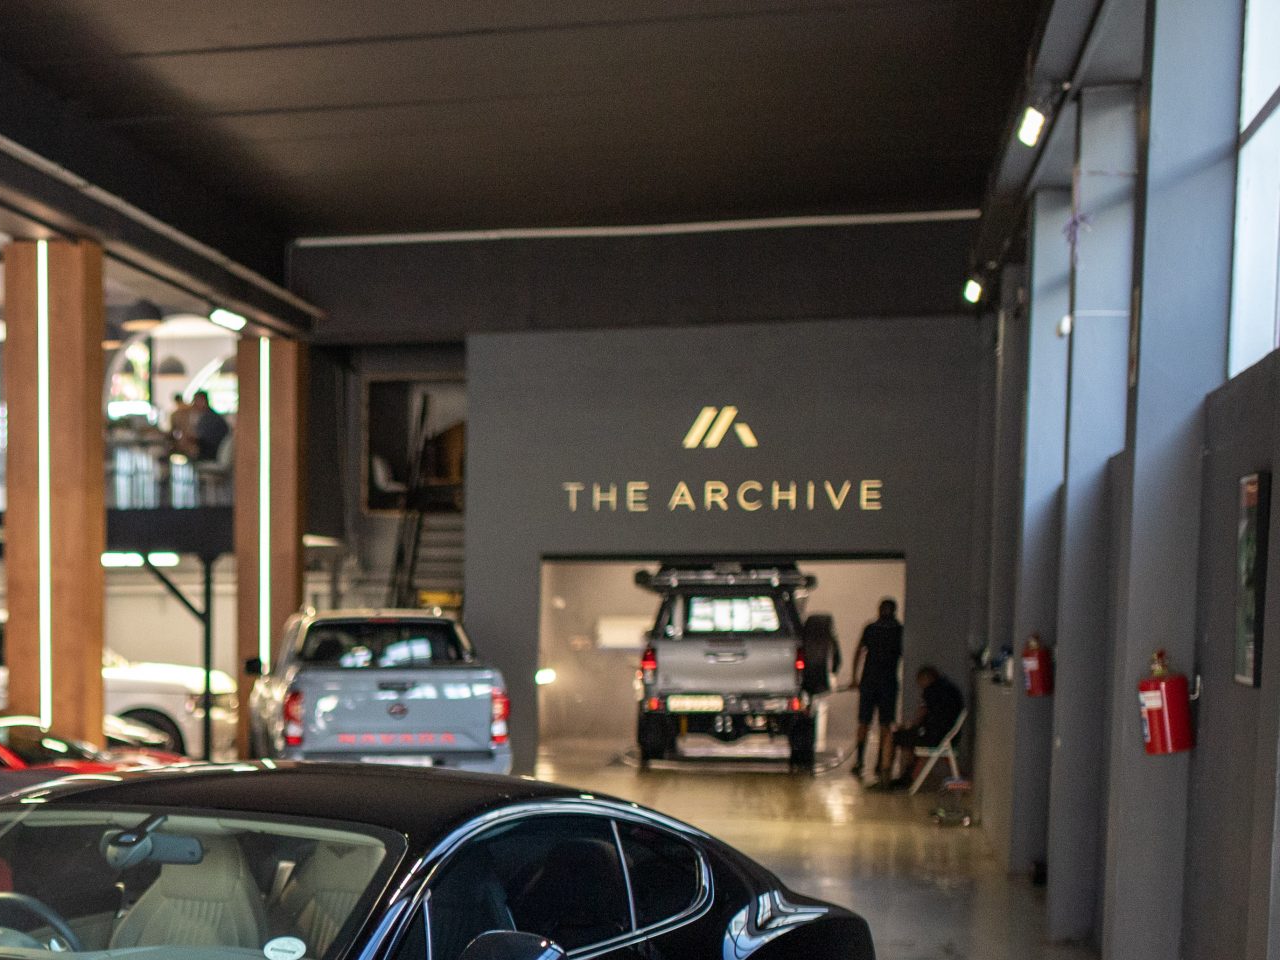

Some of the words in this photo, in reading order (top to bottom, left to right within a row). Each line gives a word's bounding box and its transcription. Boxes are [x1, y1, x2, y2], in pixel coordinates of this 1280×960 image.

[563, 481, 650, 512] THE
[668, 479, 883, 511] ARCHIVE
[338, 732, 455, 744] NAVARA
